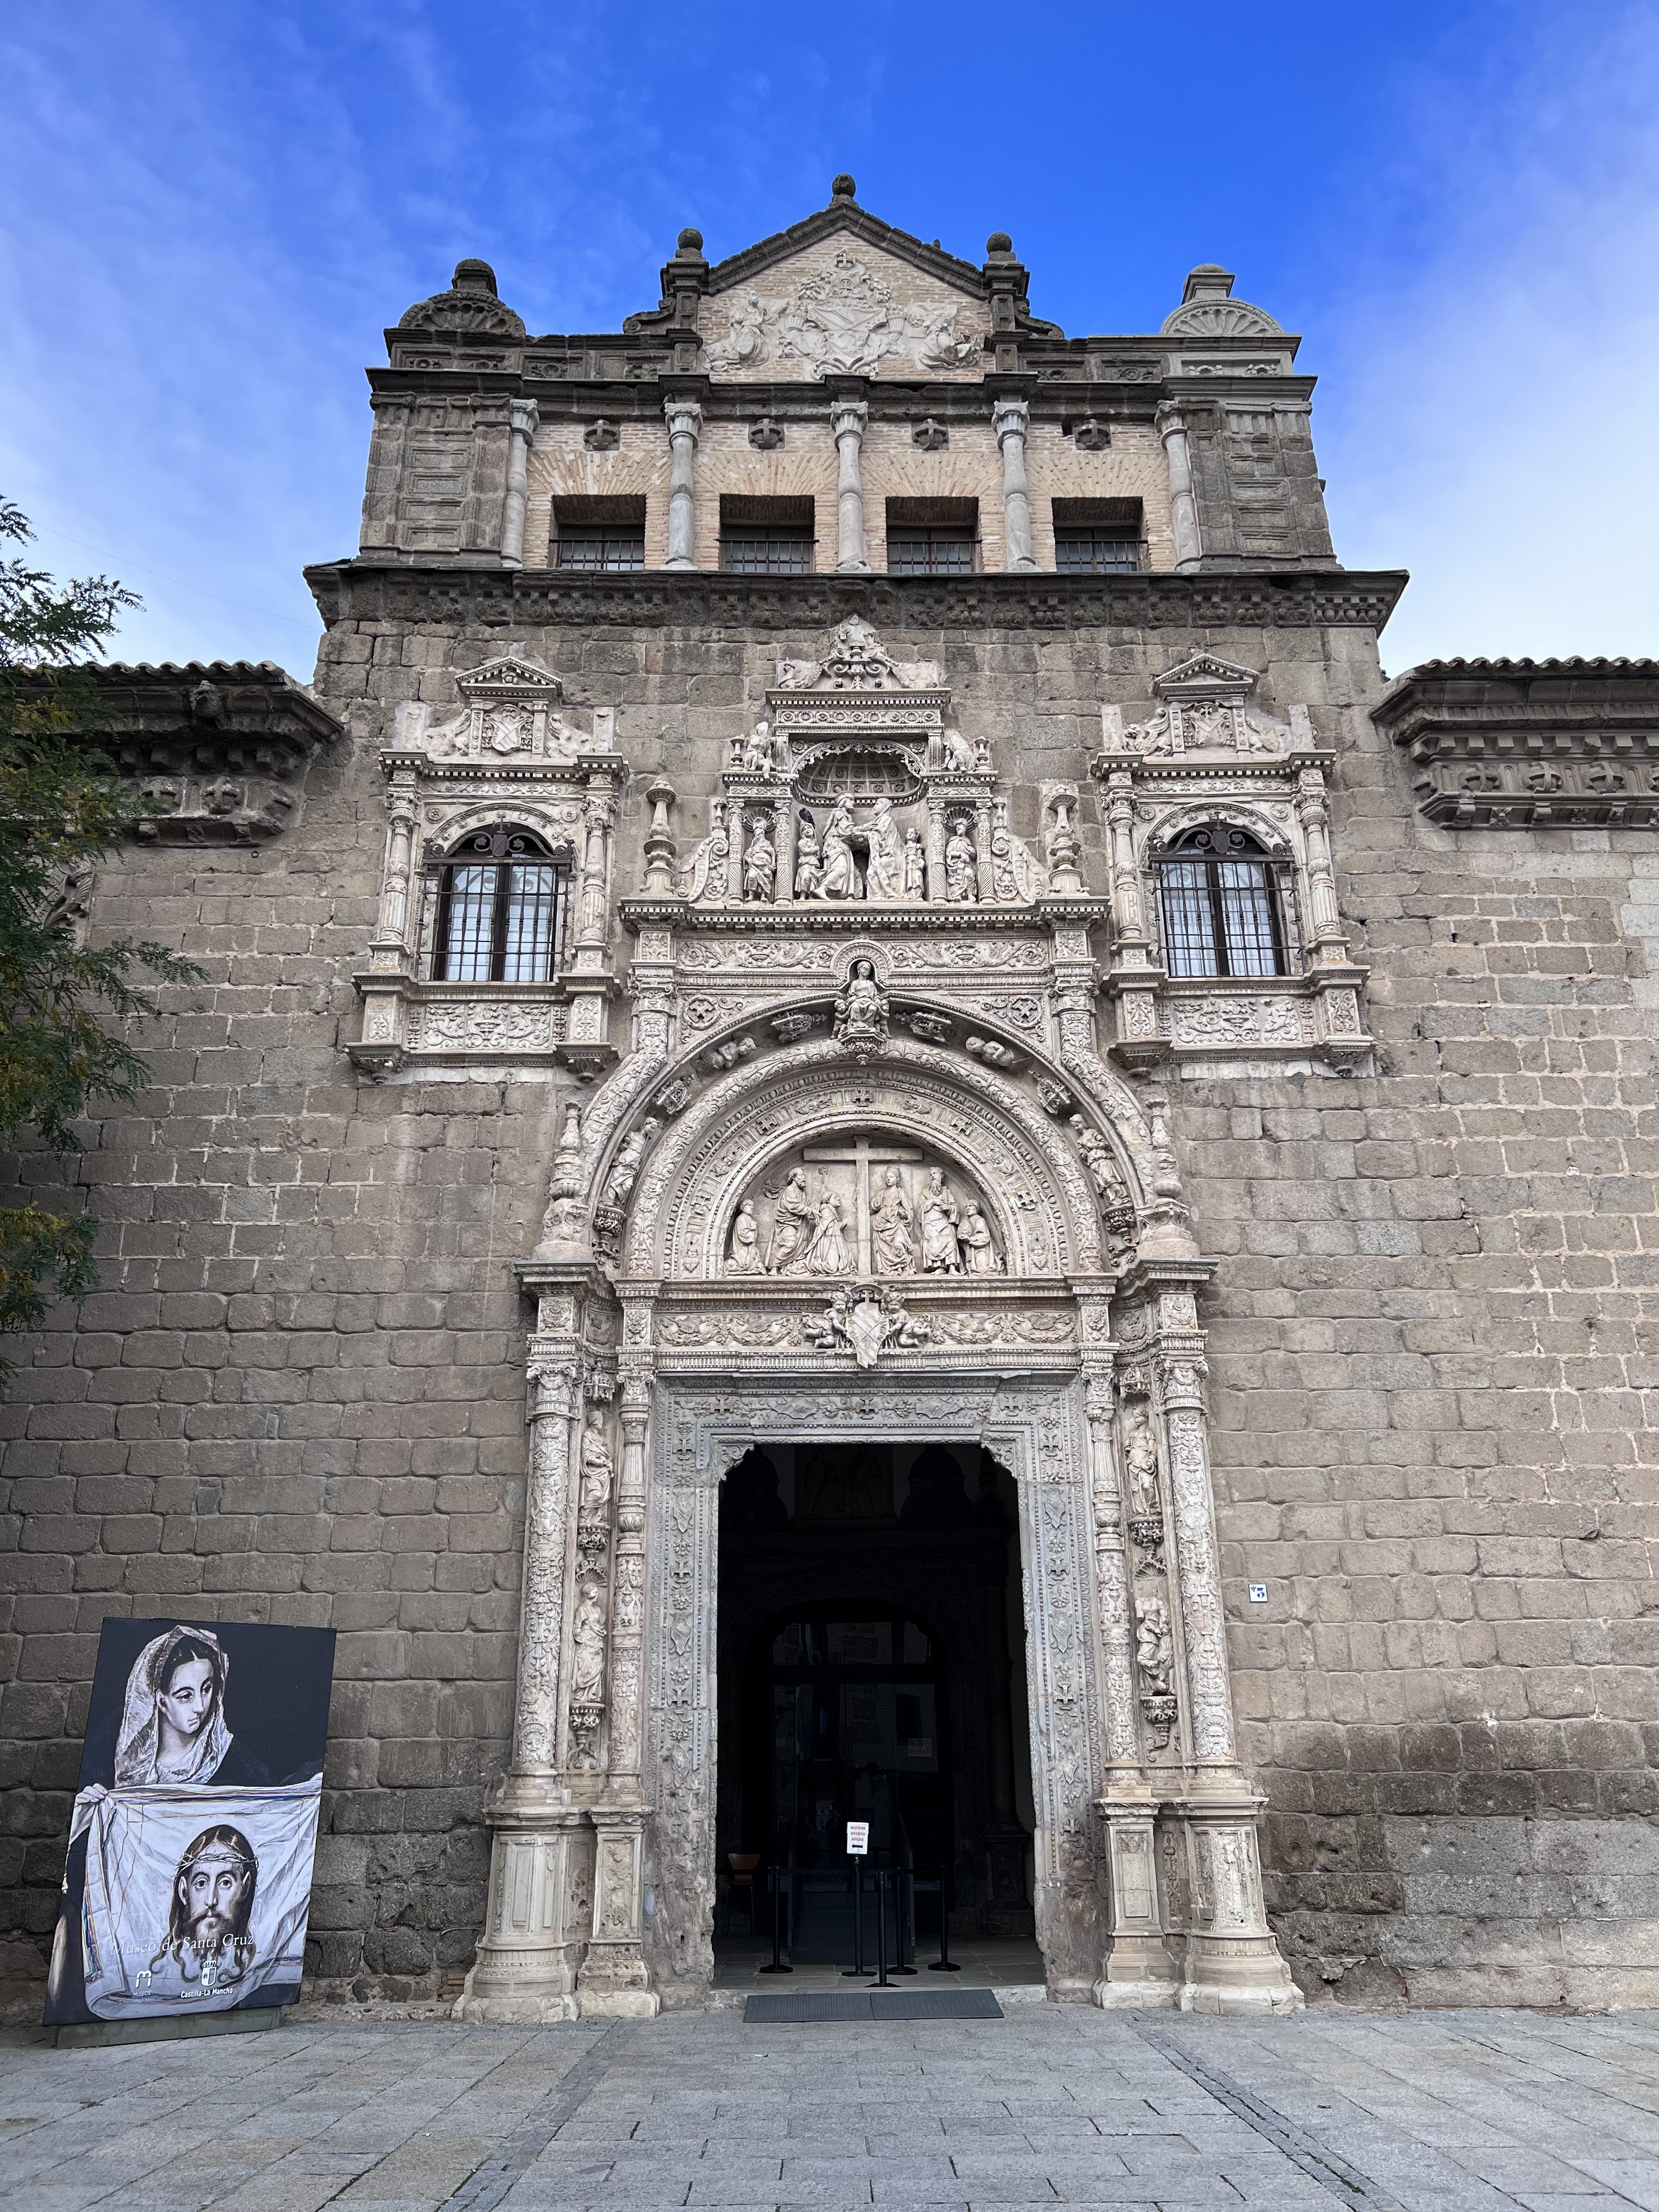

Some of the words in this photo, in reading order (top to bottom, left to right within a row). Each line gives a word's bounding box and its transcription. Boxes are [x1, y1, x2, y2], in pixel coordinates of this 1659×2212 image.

[1257, 1588, 1265, 1598] 3
[110, 1942, 156, 1955] Museo
[162, 1936, 178, 1951] de
[182, 1937, 217, 1950] Santa
[222, 1933, 254, 1947] Cruz
[180, 1989, 211, 1998] Castilla-La
[212, 1987, 233, 1996] Mancha
